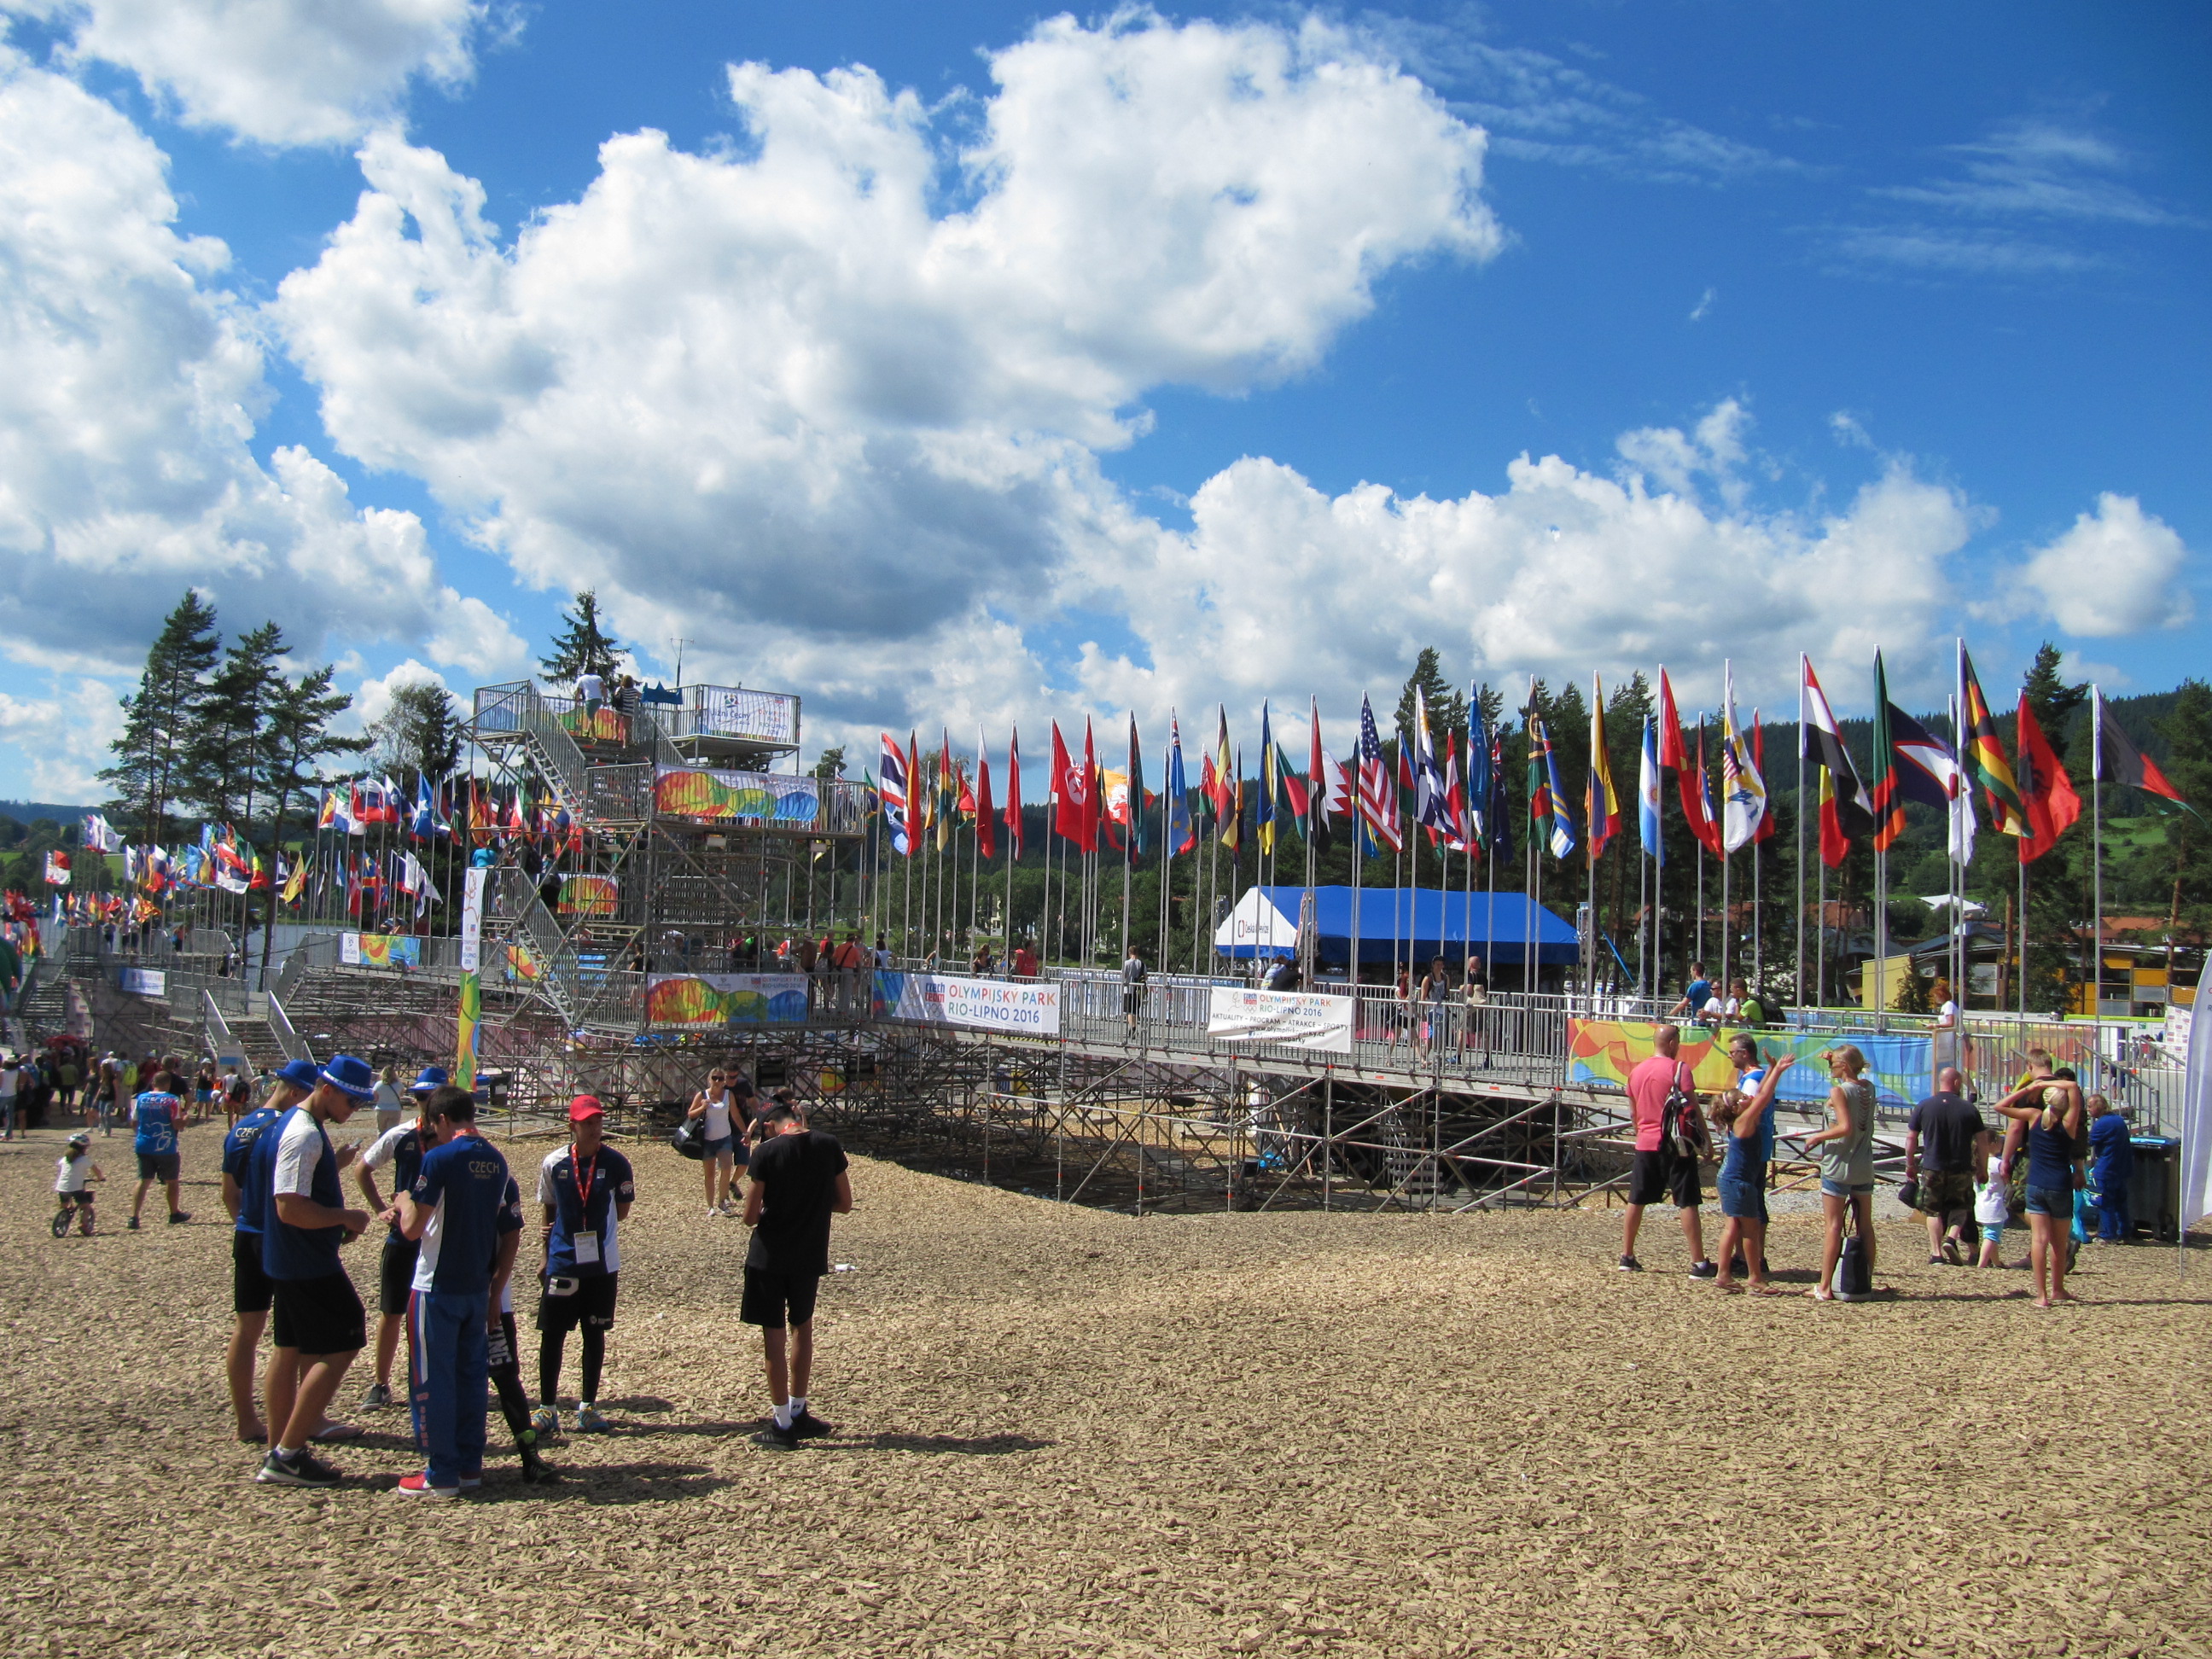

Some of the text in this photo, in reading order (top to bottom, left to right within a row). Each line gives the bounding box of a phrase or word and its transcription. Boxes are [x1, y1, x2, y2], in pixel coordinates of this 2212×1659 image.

[949, 985, 1056, 1005] OLYMPIJSKÝ PARK
[1260, 994, 1332, 1007] OLYMPIJSKÝ PARK
[948, 1002, 1039, 1023] RIO-LIPNO 2016
[1260, 1004, 1322, 1016] RIO-LIPNO 2016
[1212, 1012, 1243, 1022] AKTUALITY
[1249, 1016, 1281, 1025] PROGRAM
[1288, 1019, 1316, 1028] ATRAKCE
[469, 1161, 500, 1174] CZECH
